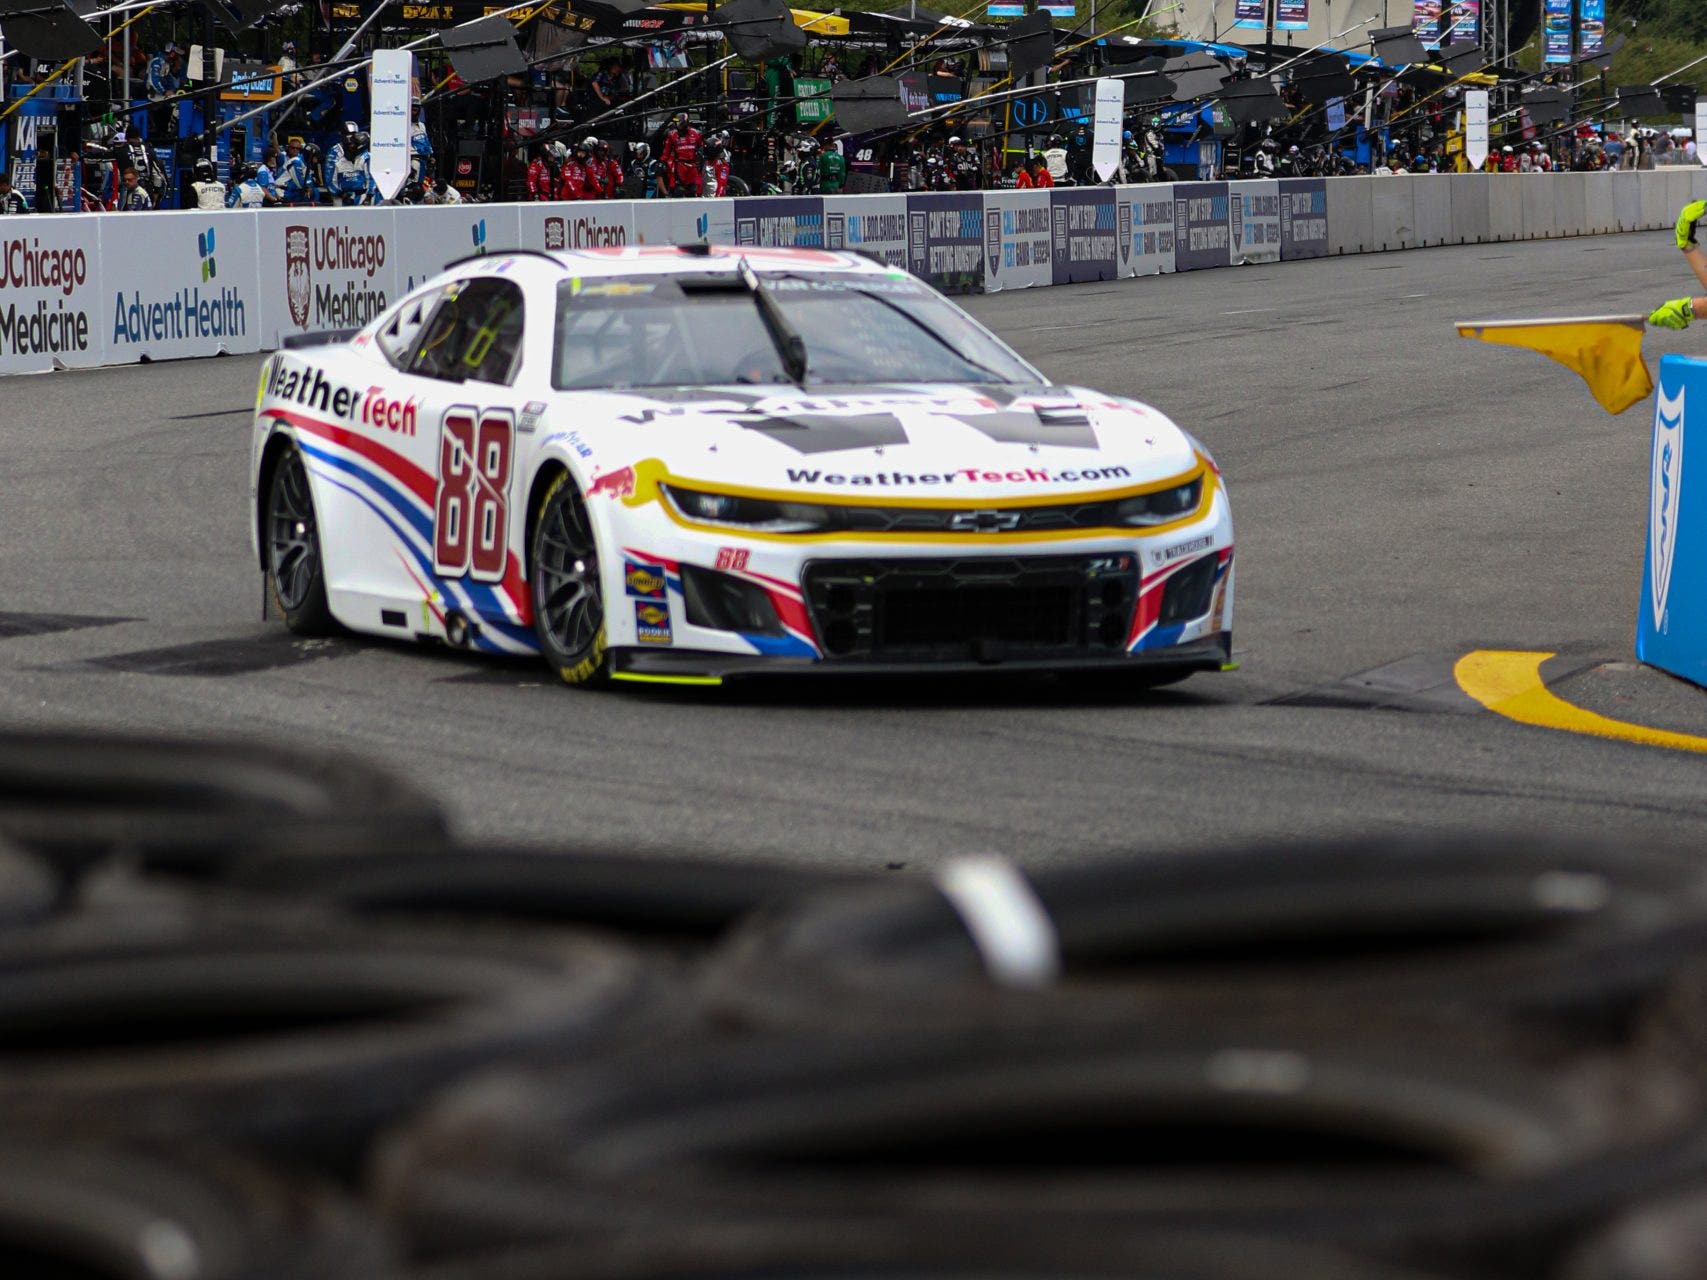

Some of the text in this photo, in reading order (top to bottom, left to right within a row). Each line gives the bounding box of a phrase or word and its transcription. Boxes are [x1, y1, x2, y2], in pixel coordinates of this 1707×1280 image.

[856, 149, 873, 161] 48
[313, 226, 385, 277] UChicago
[567, 217, 626, 249] UChicago
[113, 286, 246, 345] AdventHealth
[315, 280, 387, 330] Medicine
[267, 354, 416, 437] WeatherTech
[433, 404, 515, 586] 88
[786, 466, 1131, 486] WeatherTech.com
[714, 546, 750, 571] 88
[638, 627, 671, 636] ROOKIE
